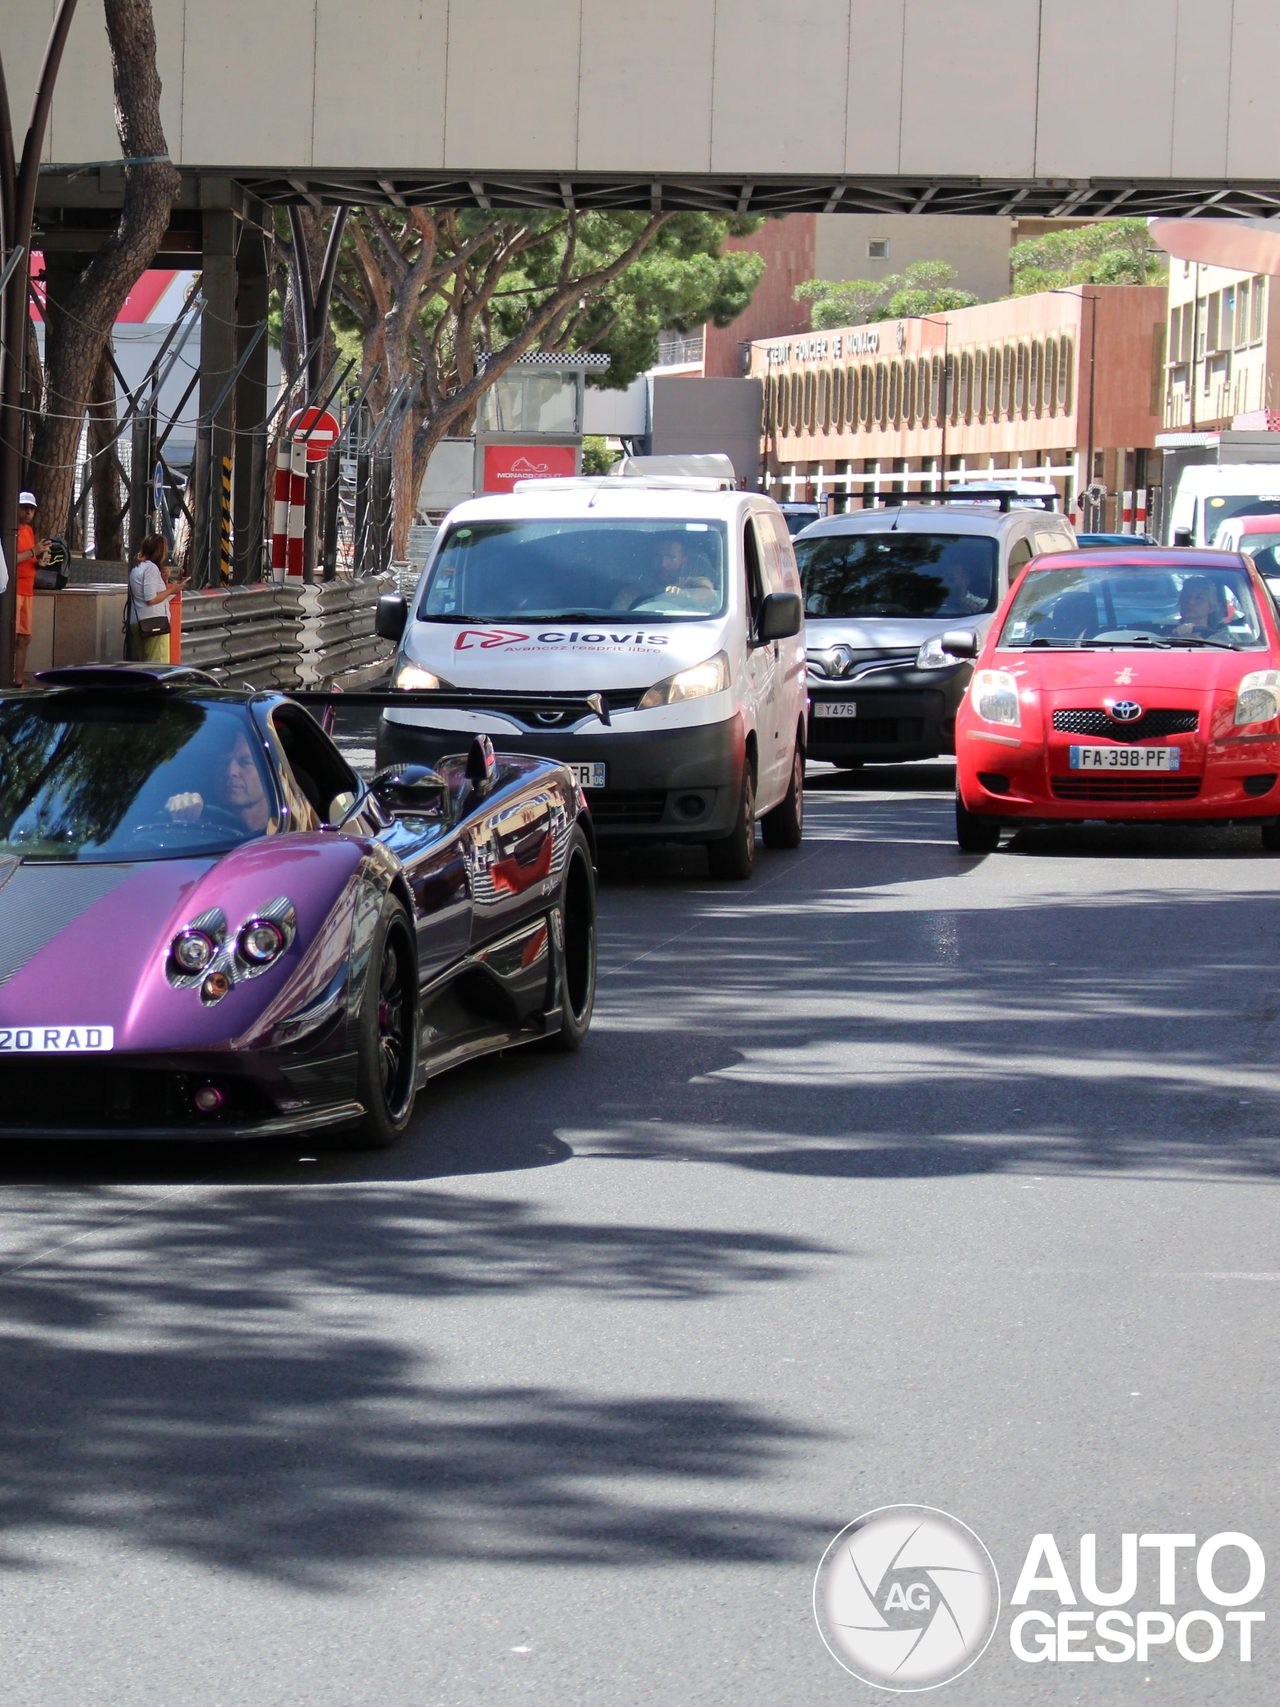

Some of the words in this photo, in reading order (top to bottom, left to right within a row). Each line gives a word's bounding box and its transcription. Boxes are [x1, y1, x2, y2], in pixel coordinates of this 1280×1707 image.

[795, 337, 829, 361] FONCIER
[832, 335, 843, 358] DE
[846, 329, 880, 355] MONACO
[537, 631, 669, 646] Clovis
[504, 645, 568, 653] Avancez
[571, 644, 624, 652] l'esprit
[628, 646, 662, 654] libre
[825, 704, 854, 716] Y476
[1082, 749, 1167, 767] FA-398-PF
[1170, 759, 1179, 768] 06
[594, 775, 604, 785] 06
[43, 1028, 103, 1050] RAD
